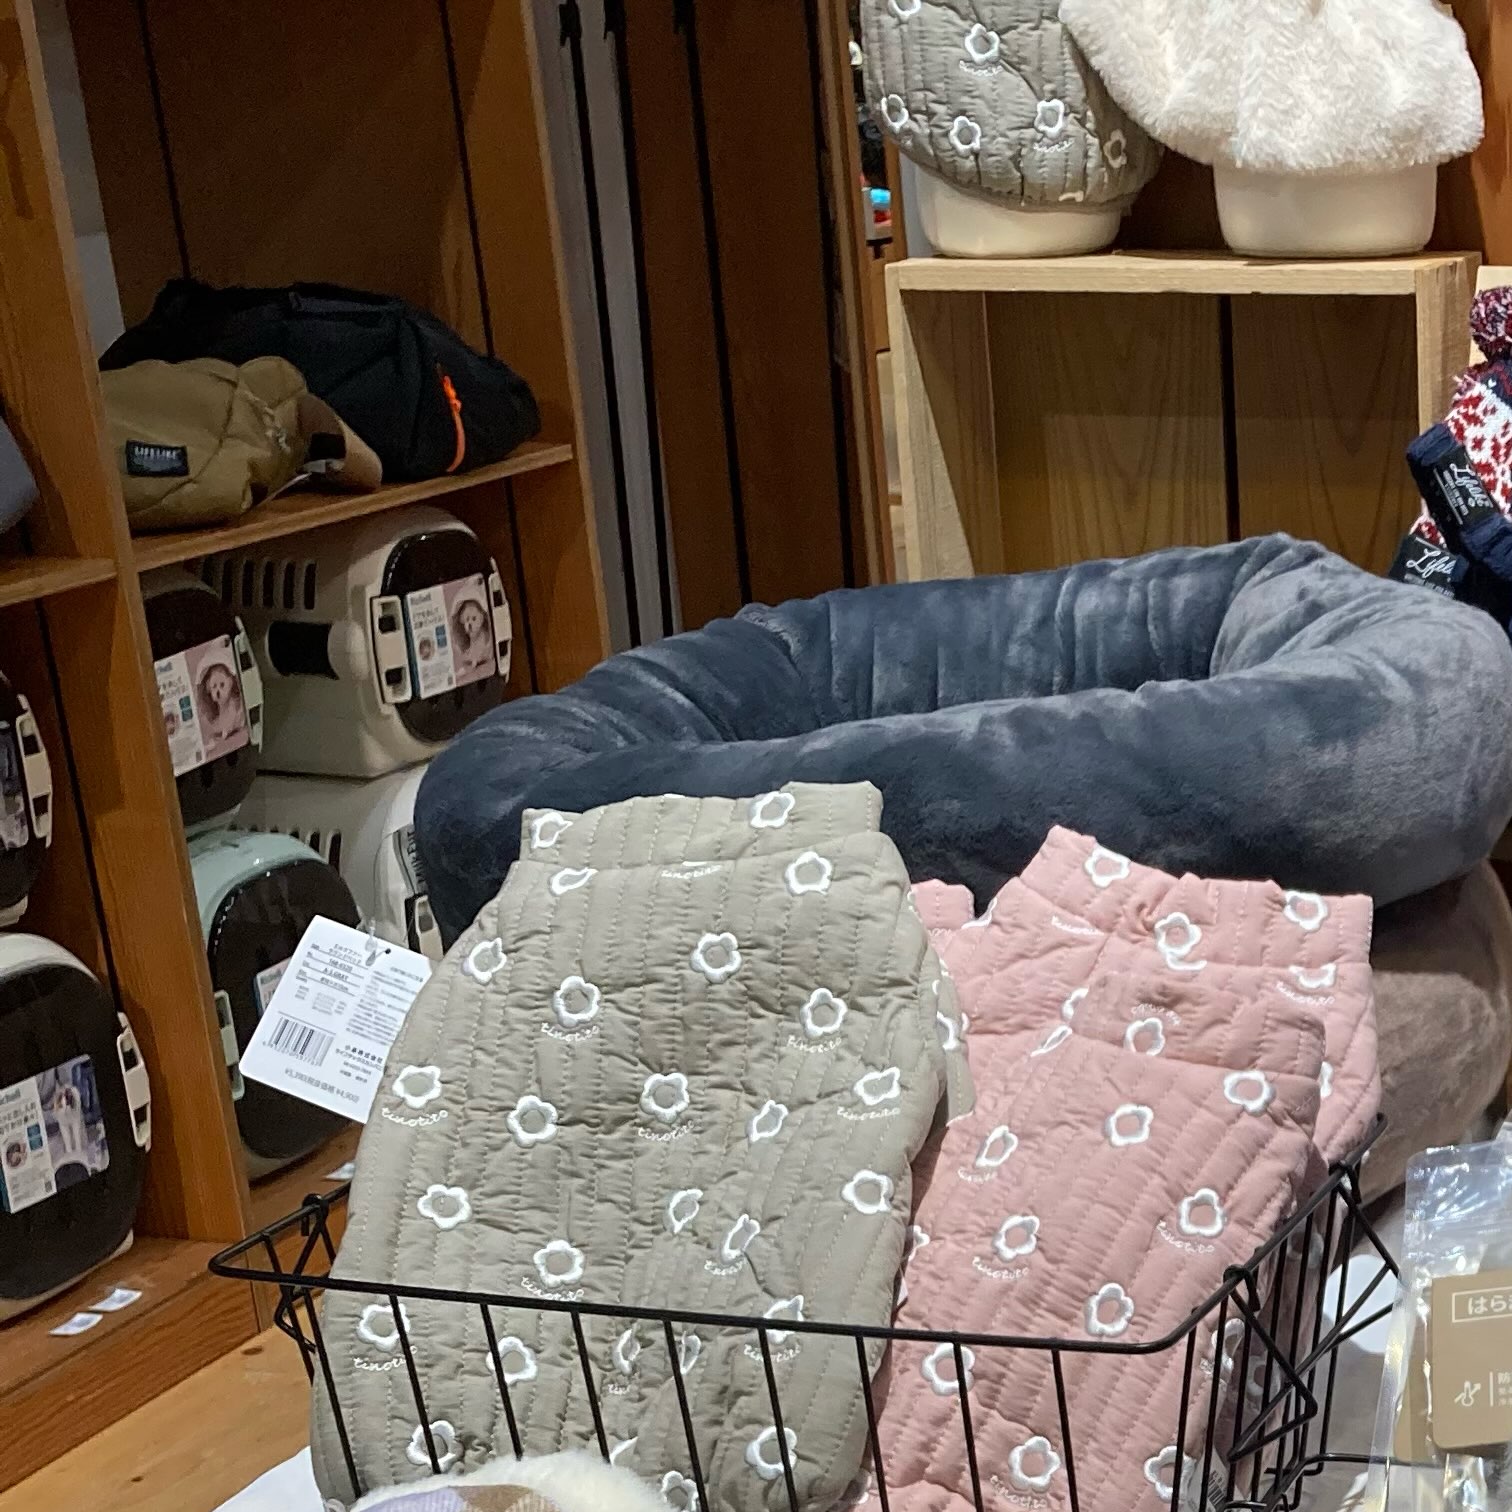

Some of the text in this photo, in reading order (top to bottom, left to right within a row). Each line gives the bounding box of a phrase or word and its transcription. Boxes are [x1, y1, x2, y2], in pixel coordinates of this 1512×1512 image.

[540, 1022, 600, 1043] tinotito
[381, 1106, 449, 1127] tinotito
[353, 1345, 418, 1371] tinotio
